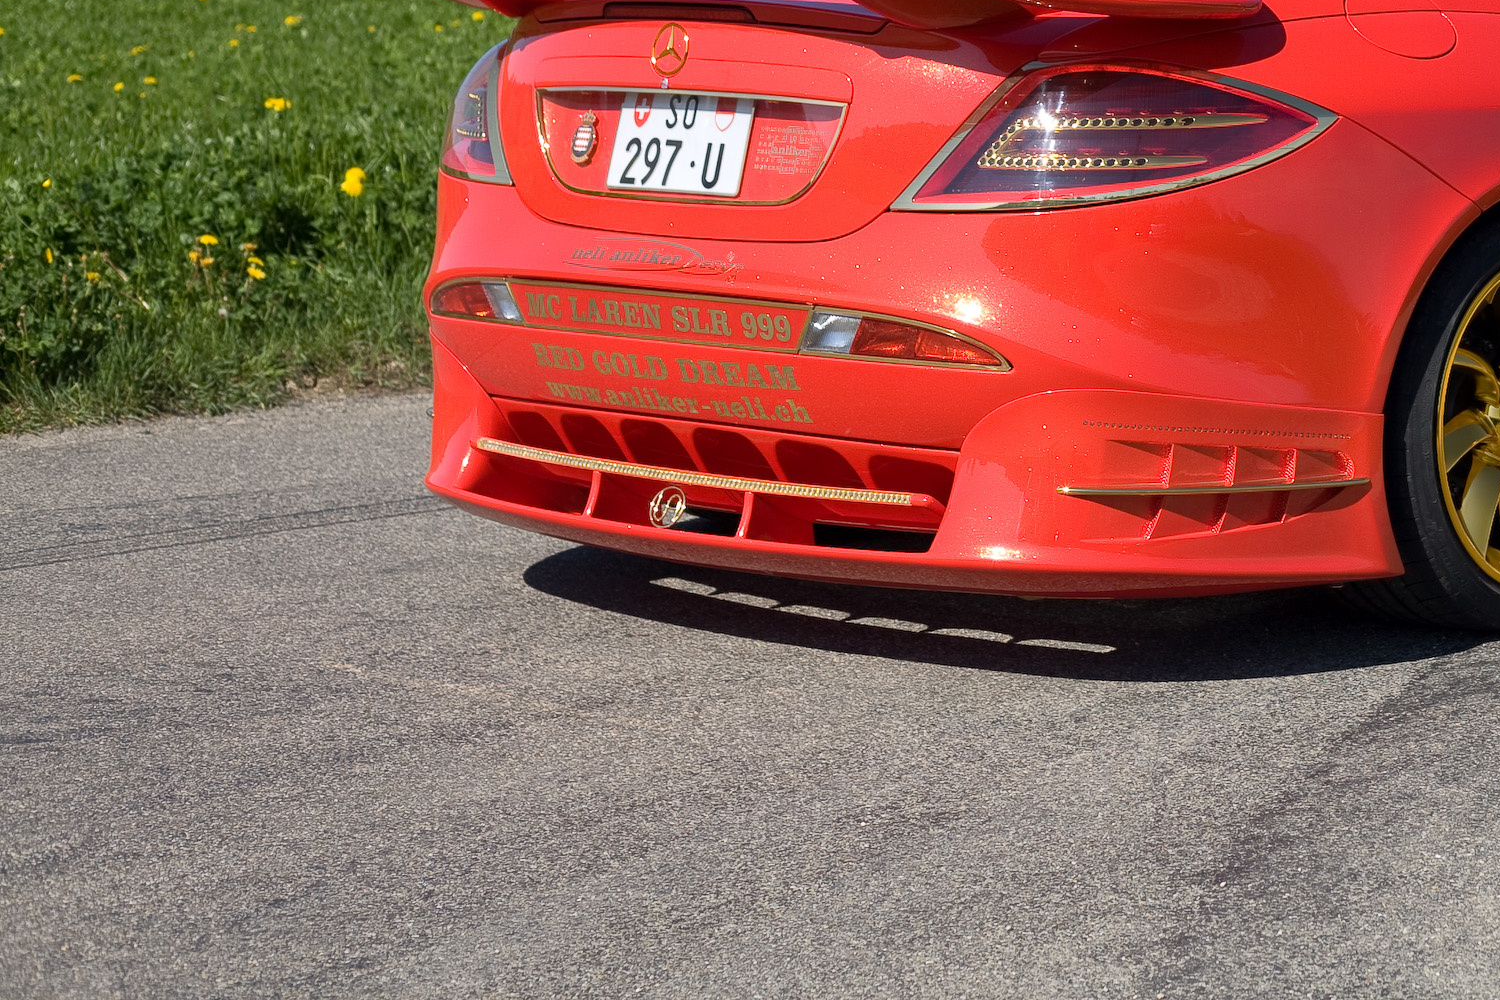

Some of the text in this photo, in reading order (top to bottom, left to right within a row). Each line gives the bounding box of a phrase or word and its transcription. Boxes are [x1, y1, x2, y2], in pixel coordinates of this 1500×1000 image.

[665, 94, 699, 129] SO
[610, 247, 682, 266] anliker
[525, 292, 792, 343] MC LAREN SLR 999
[531, 342, 801, 391] RED GOLD DREAM
[545, 381, 814, 424] www.anliker-ueli.ch
